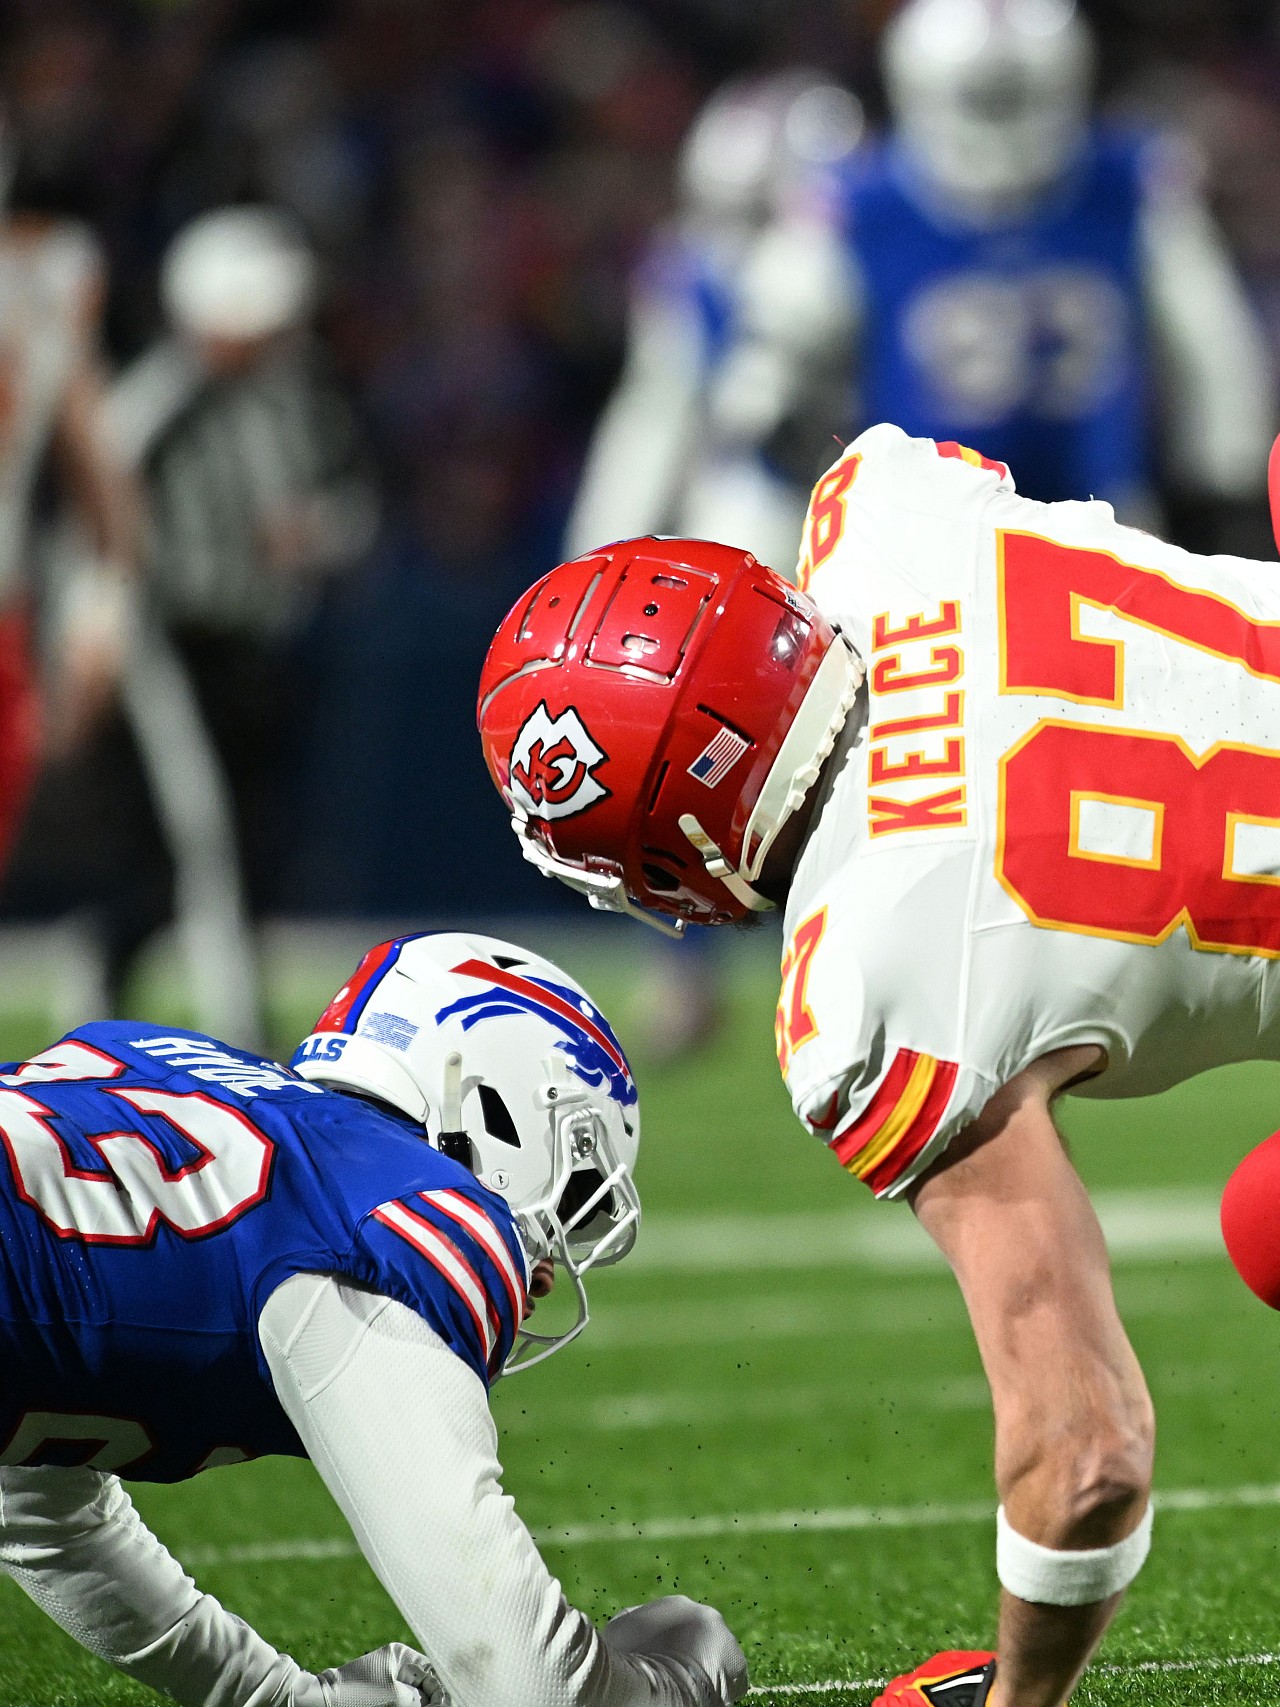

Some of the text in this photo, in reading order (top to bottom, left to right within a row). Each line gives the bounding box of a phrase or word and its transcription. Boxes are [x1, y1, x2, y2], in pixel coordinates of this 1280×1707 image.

[797, 452, 863, 592] 8
[511, 734, 588, 808] KC
[867, 600, 967, 839] KELCE
[775, 904, 829, 1080] 7
[129, 1037, 324, 1097] HYDE
